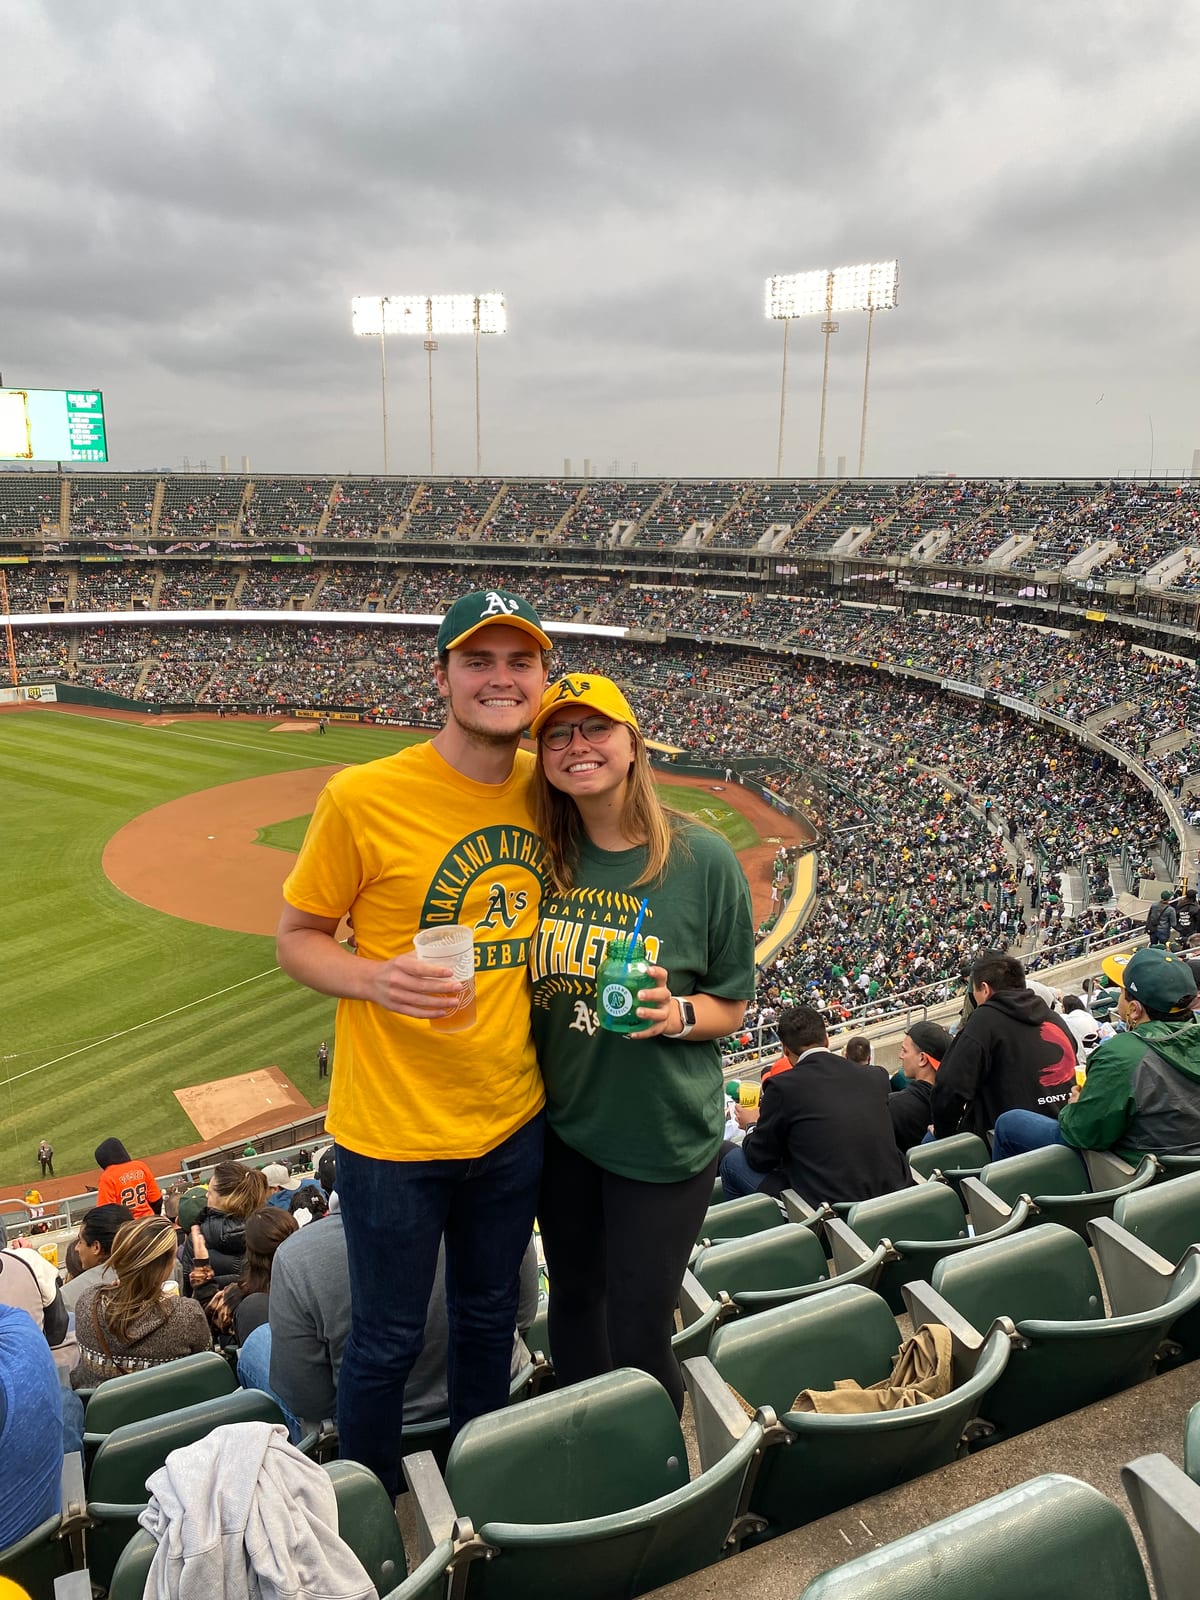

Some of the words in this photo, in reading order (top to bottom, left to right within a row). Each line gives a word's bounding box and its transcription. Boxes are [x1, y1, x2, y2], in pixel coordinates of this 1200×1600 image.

[480, 591, 519, 618] A's
[552, 679, 591, 702] A's
[375, 717, 387, 726] Ray
[387, 718, 411, 727] Morgan
[425, 834, 493, 922] OAKLAND
[499, 830, 551, 895] ATHLE
[474, 882, 528, 930] A's
[549, 904, 639, 927] OAKLAN
[473, 942, 526, 968] SEBA
[529, 917, 661, 983] ATHLETS
[568, 1000, 600, 1036] A's
[1037, 1093, 1067, 1105] SONY
[120, 1182, 147, 1209] 28
